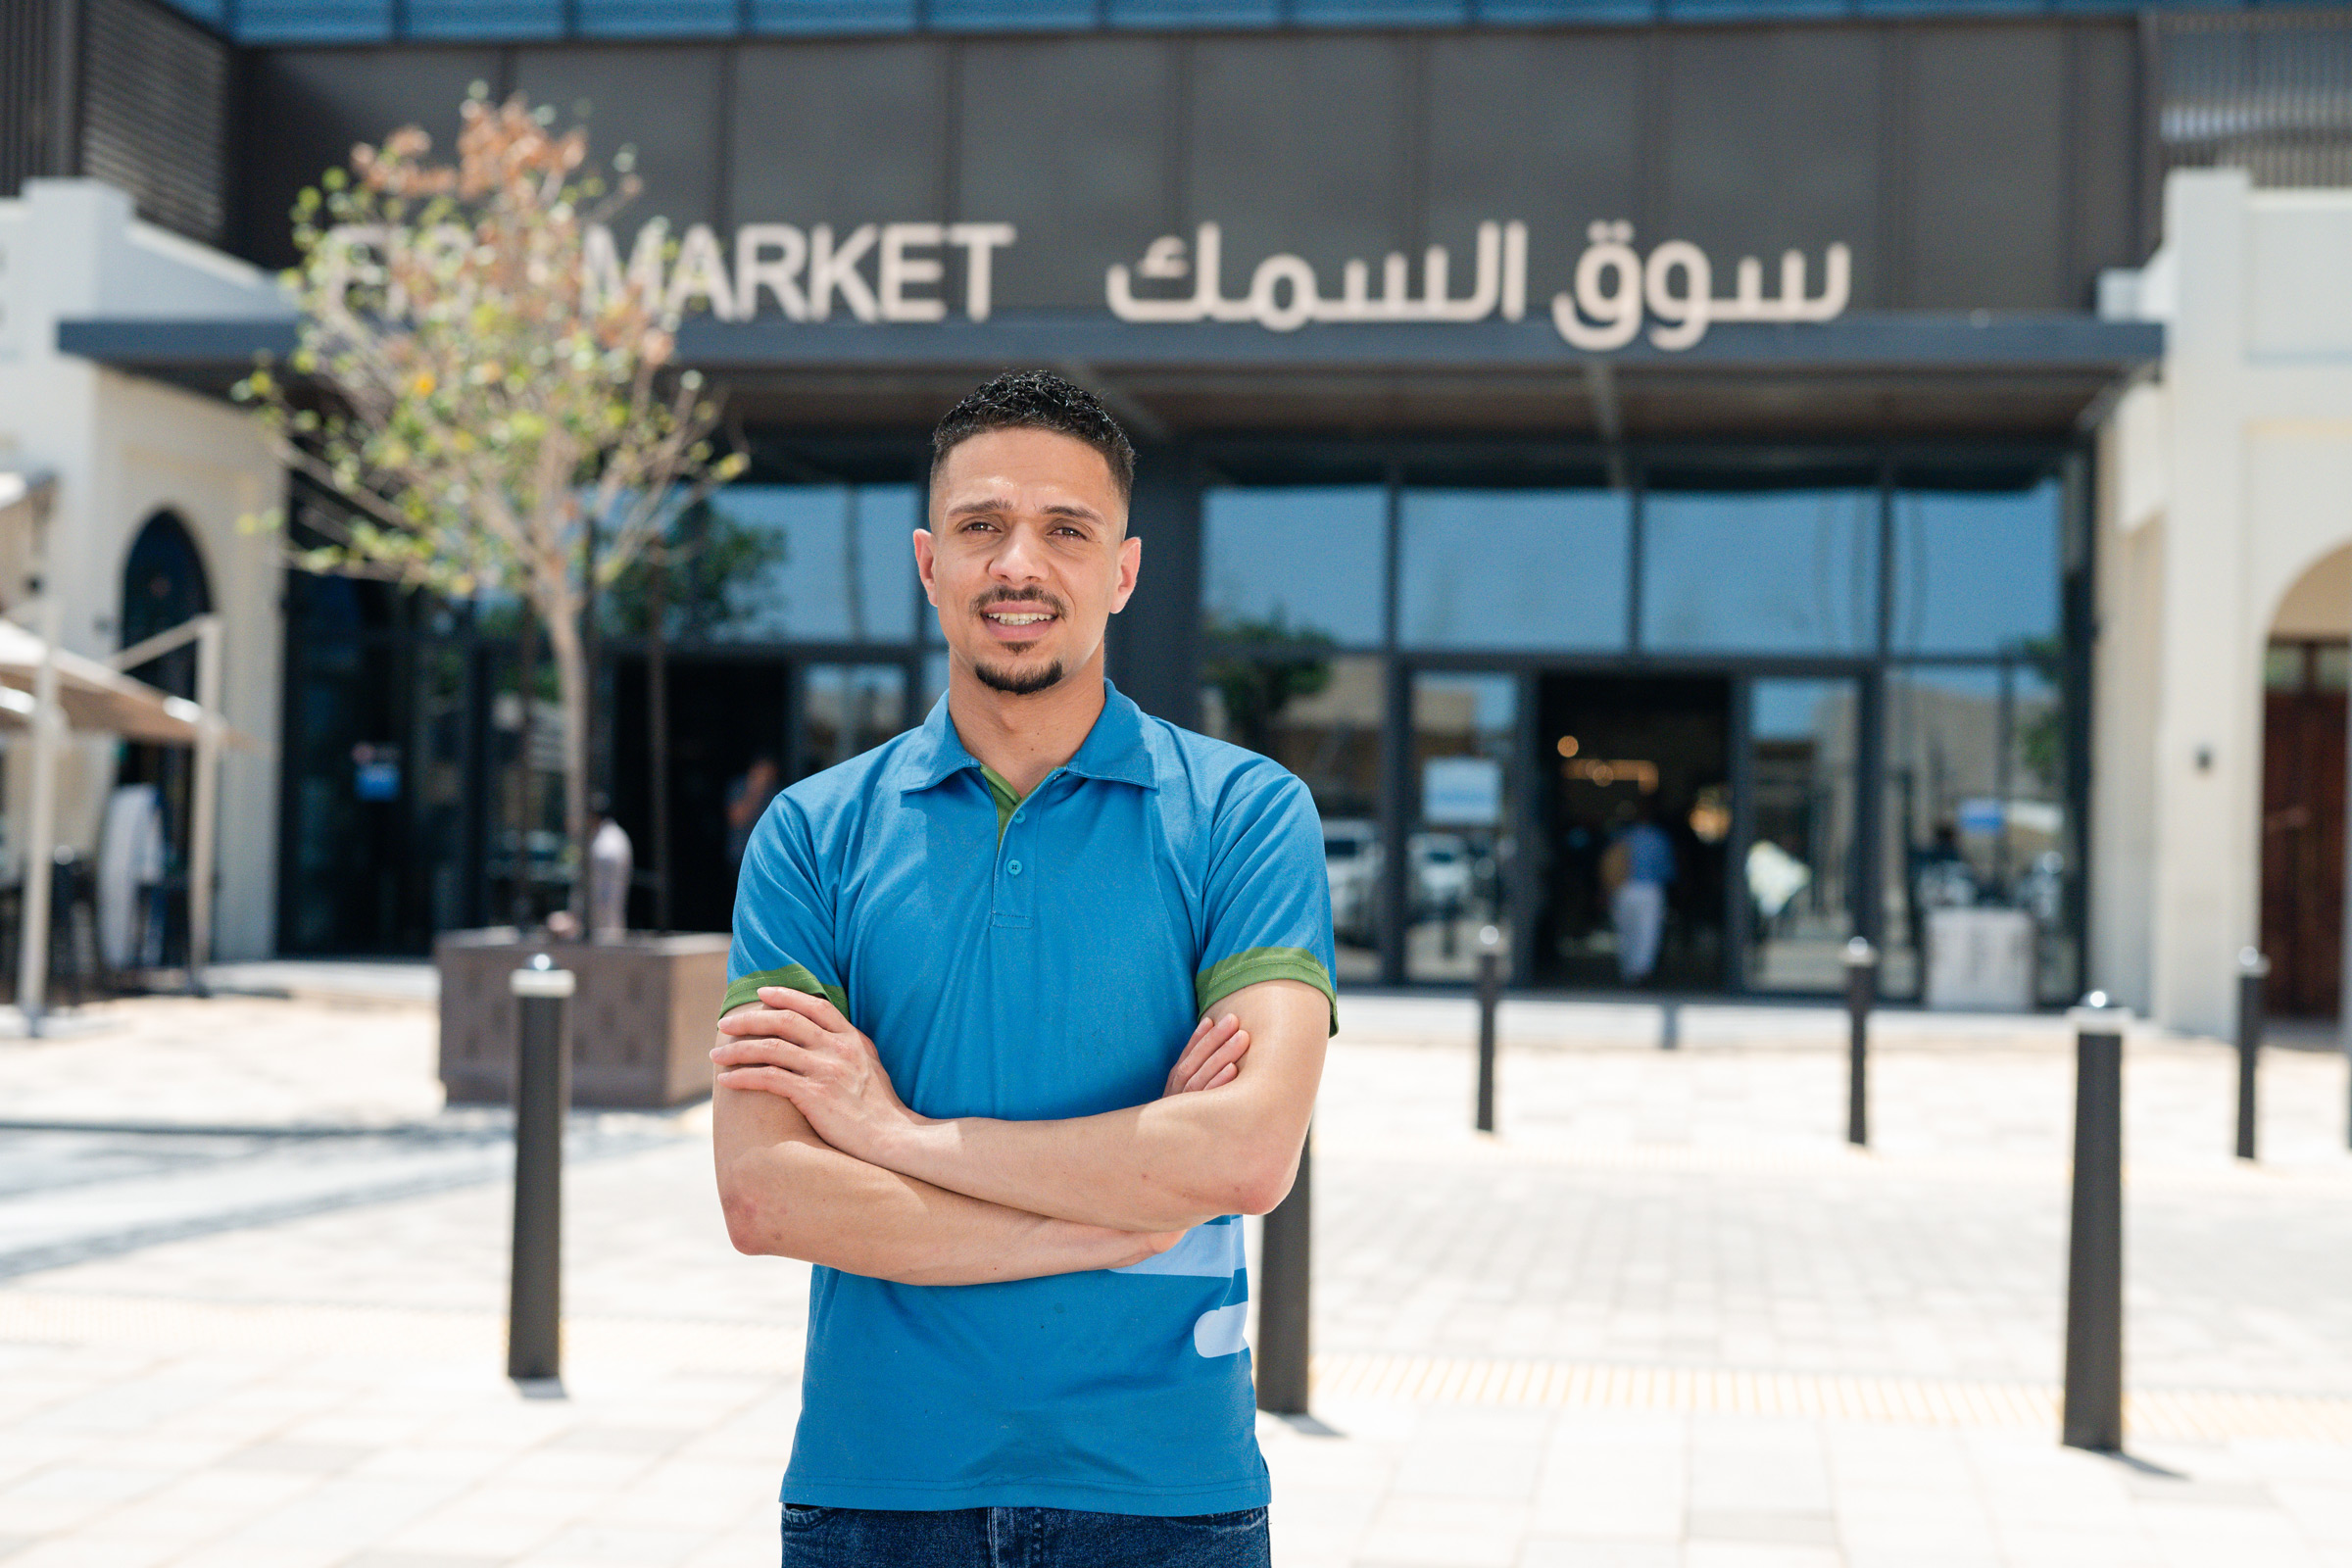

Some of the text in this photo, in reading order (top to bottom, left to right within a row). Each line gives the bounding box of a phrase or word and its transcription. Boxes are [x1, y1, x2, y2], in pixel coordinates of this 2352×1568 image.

[581, 221, 1017, 324] MARKET
[1106, 220, 1850, 351] سوق السمك
